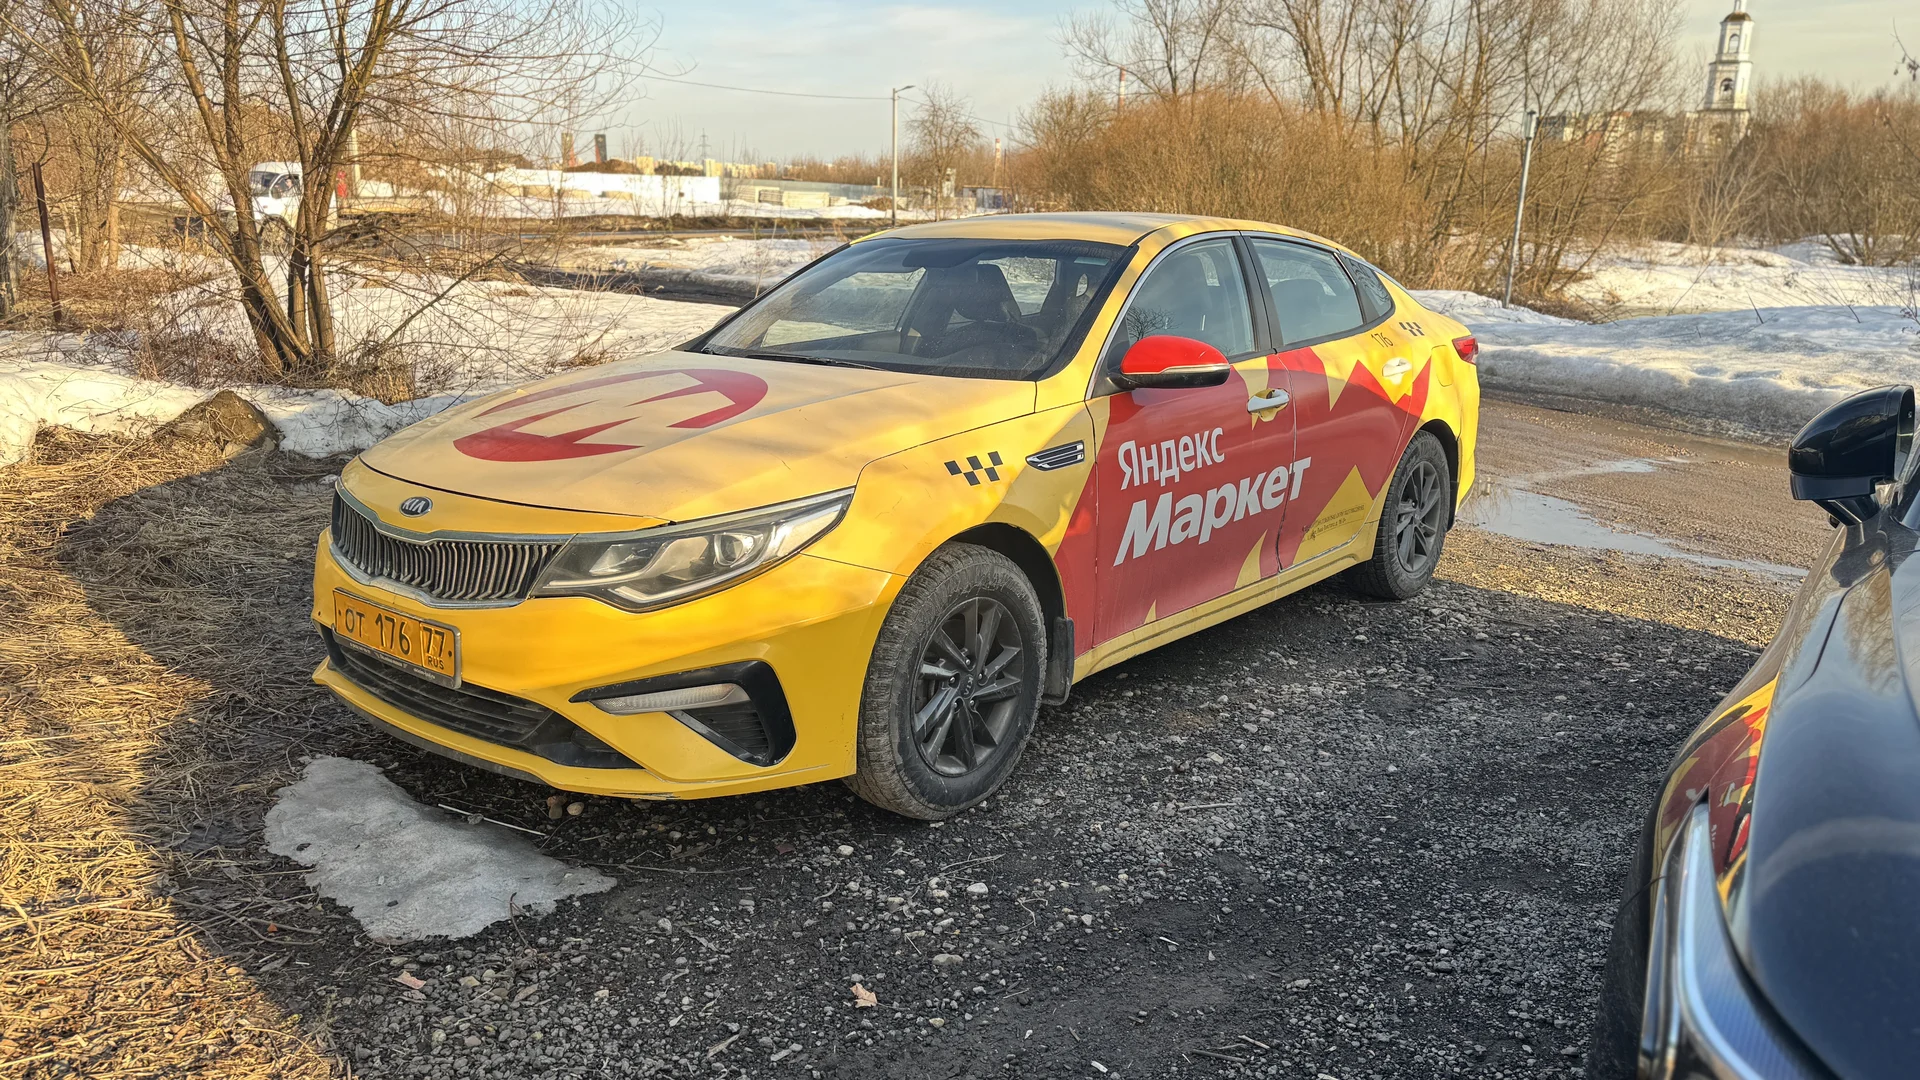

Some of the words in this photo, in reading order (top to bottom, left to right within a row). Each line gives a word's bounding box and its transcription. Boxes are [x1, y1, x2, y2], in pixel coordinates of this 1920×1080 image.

[1370, 332, 1394, 348] 176
[1117, 427, 1225, 491] Яндекс
[402, 498, 426, 514] KIA
[1113, 456, 1312, 567] Маркет
[375, 612, 412, 656] 176
[422, 626, 446, 658] 77
[427, 656, 445, 670] RUS
